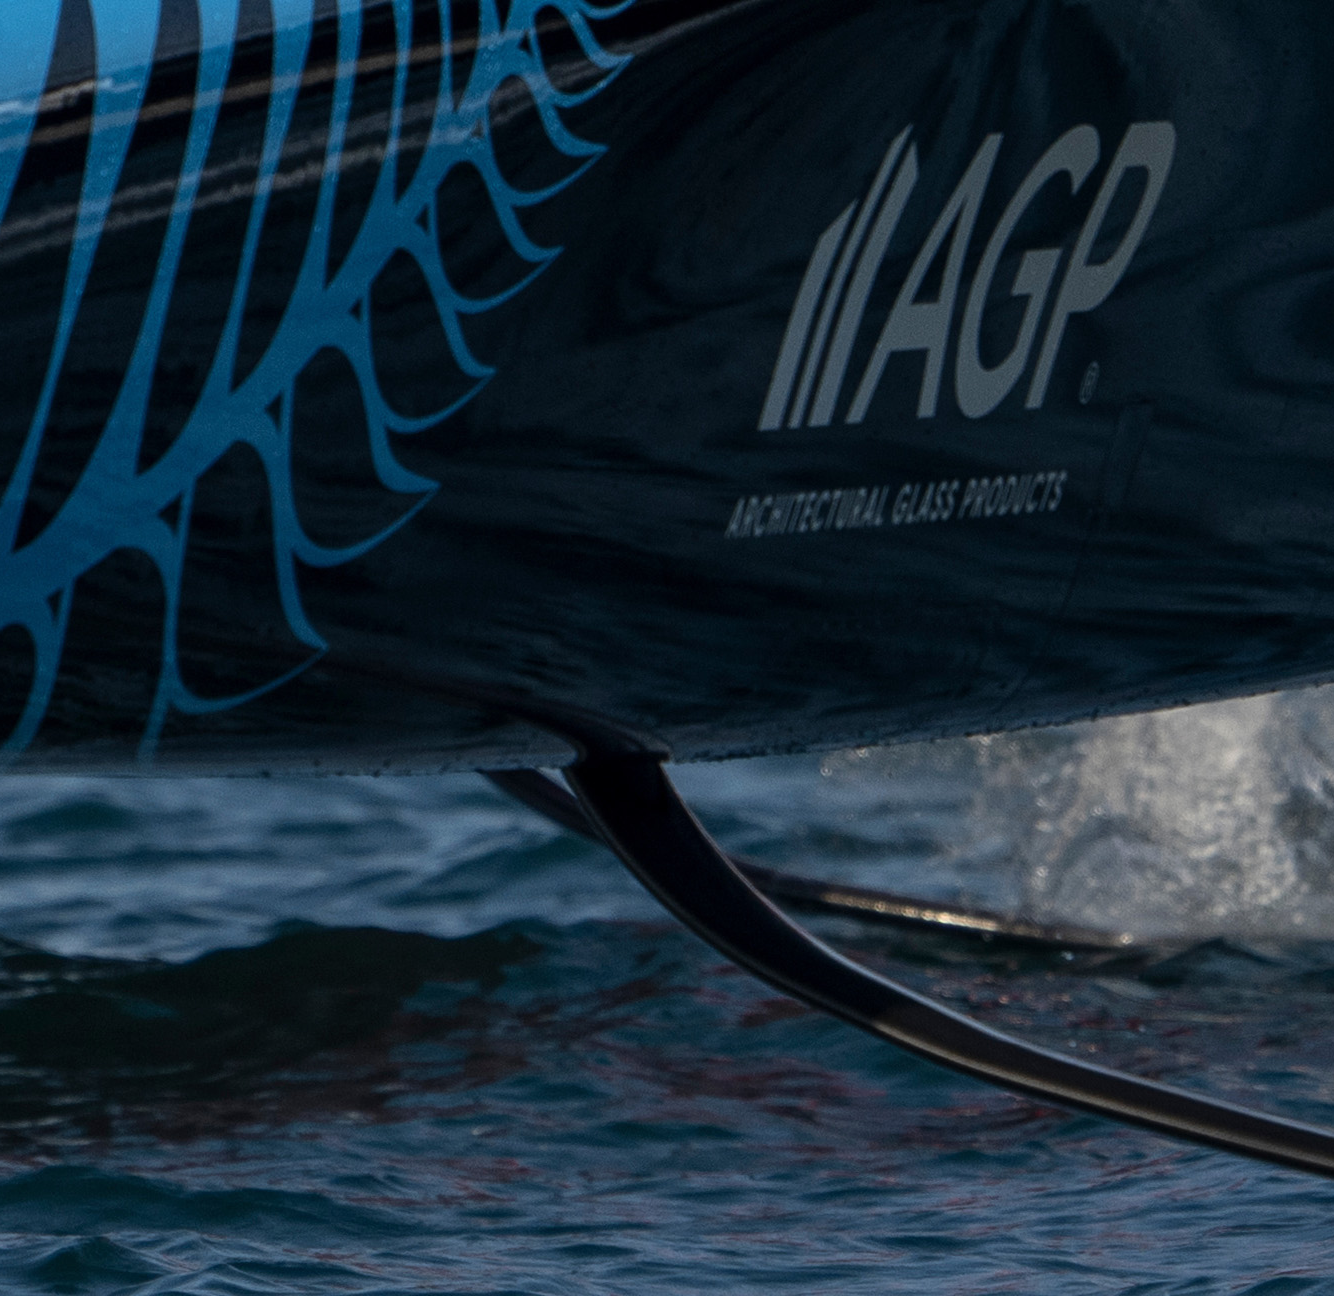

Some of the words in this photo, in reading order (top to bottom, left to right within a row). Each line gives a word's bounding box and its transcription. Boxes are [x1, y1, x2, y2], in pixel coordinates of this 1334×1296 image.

[845, 121, 1177, 424] AGP
[726, 485, 888, 538] ARCHITECTURAL
[891, 478, 959, 525] GLASS
[958, 470, 1067, 519] PRODUCTS
